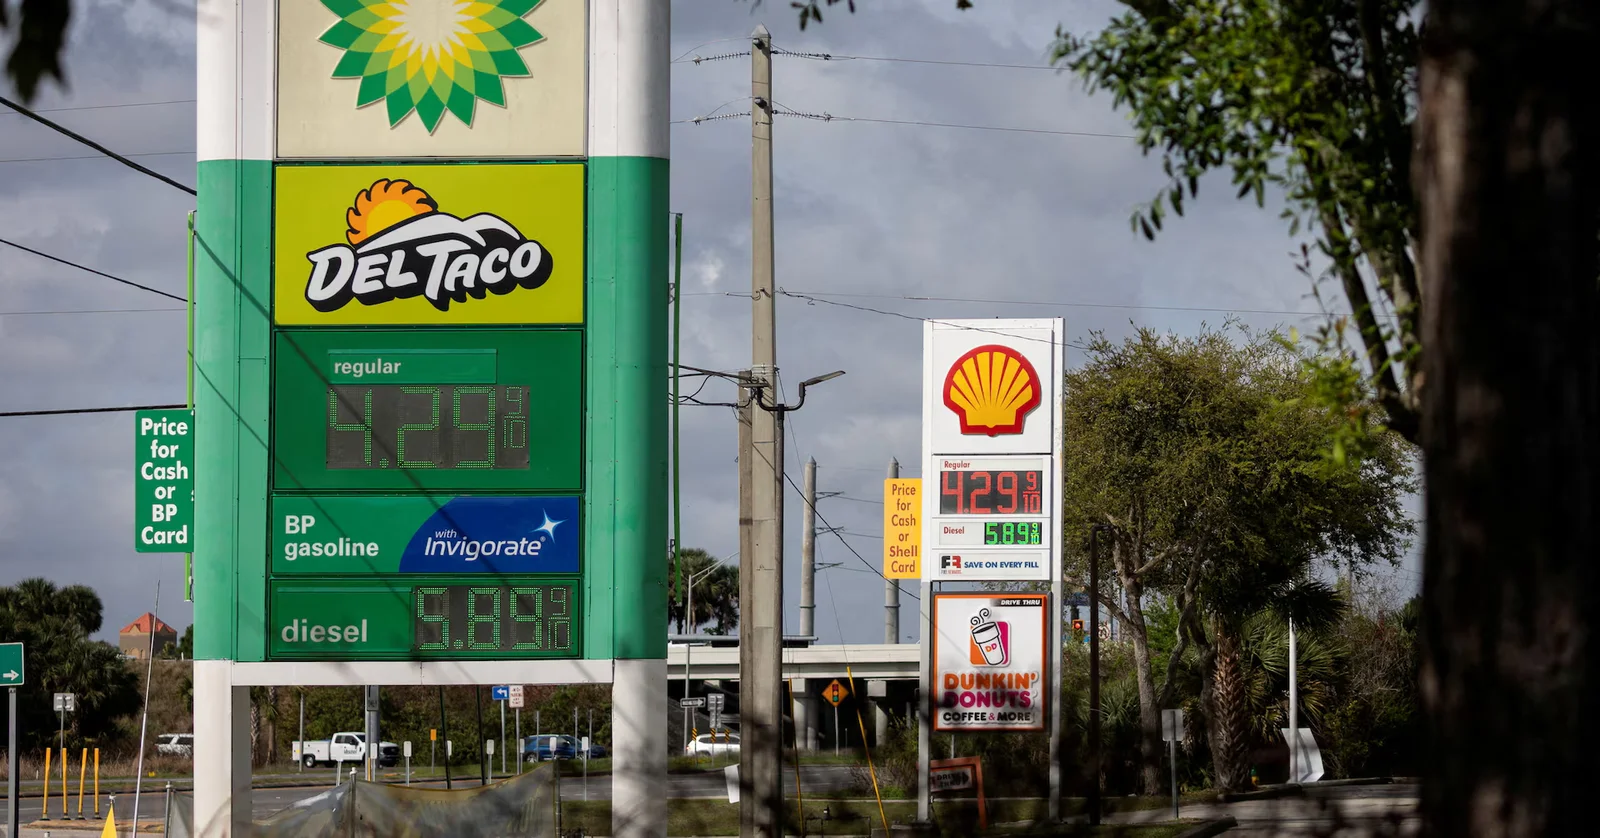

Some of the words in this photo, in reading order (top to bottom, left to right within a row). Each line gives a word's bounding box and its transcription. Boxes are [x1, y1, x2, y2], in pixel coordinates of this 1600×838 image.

[305, 245, 419, 303] DEL
[415, 239, 544, 302] TACO
[334, 358, 401, 378] regular
[141, 417, 188, 436] Price
[329, 386, 495, 468] 4.29
[150, 440, 179, 459] for
[141, 461, 189, 480] Cash
[944, 461, 970, 470] Regular
[154, 484, 176, 500] or
[892, 484, 916, 496] Price
[941, 471, 1018, 514] 4.29
[151, 504, 178, 522] BP
[896, 500, 911, 511] for
[284, 515, 316, 534] BP
[891, 514, 916, 526] Cash
[140, 525, 188, 545] Card
[434, 529, 457, 538] with
[898, 532, 909, 541] or
[943, 526, 965, 534] Diesel
[284, 538, 379, 561] gasoline
[889, 545, 918, 557] Shell
[891, 561, 916, 573] Card
[417, 587, 543, 650] 5.89
[281, 619, 368, 643] diesel
[985, 643, 997, 653] DD
[943, 673, 1036, 690] DUNKIN'
[944, 691, 1031, 709] DONUTS
[942, 712, 987, 722] COFFEE
[988, 712, 995, 721] &
[996, 712, 1031, 722] MORE
